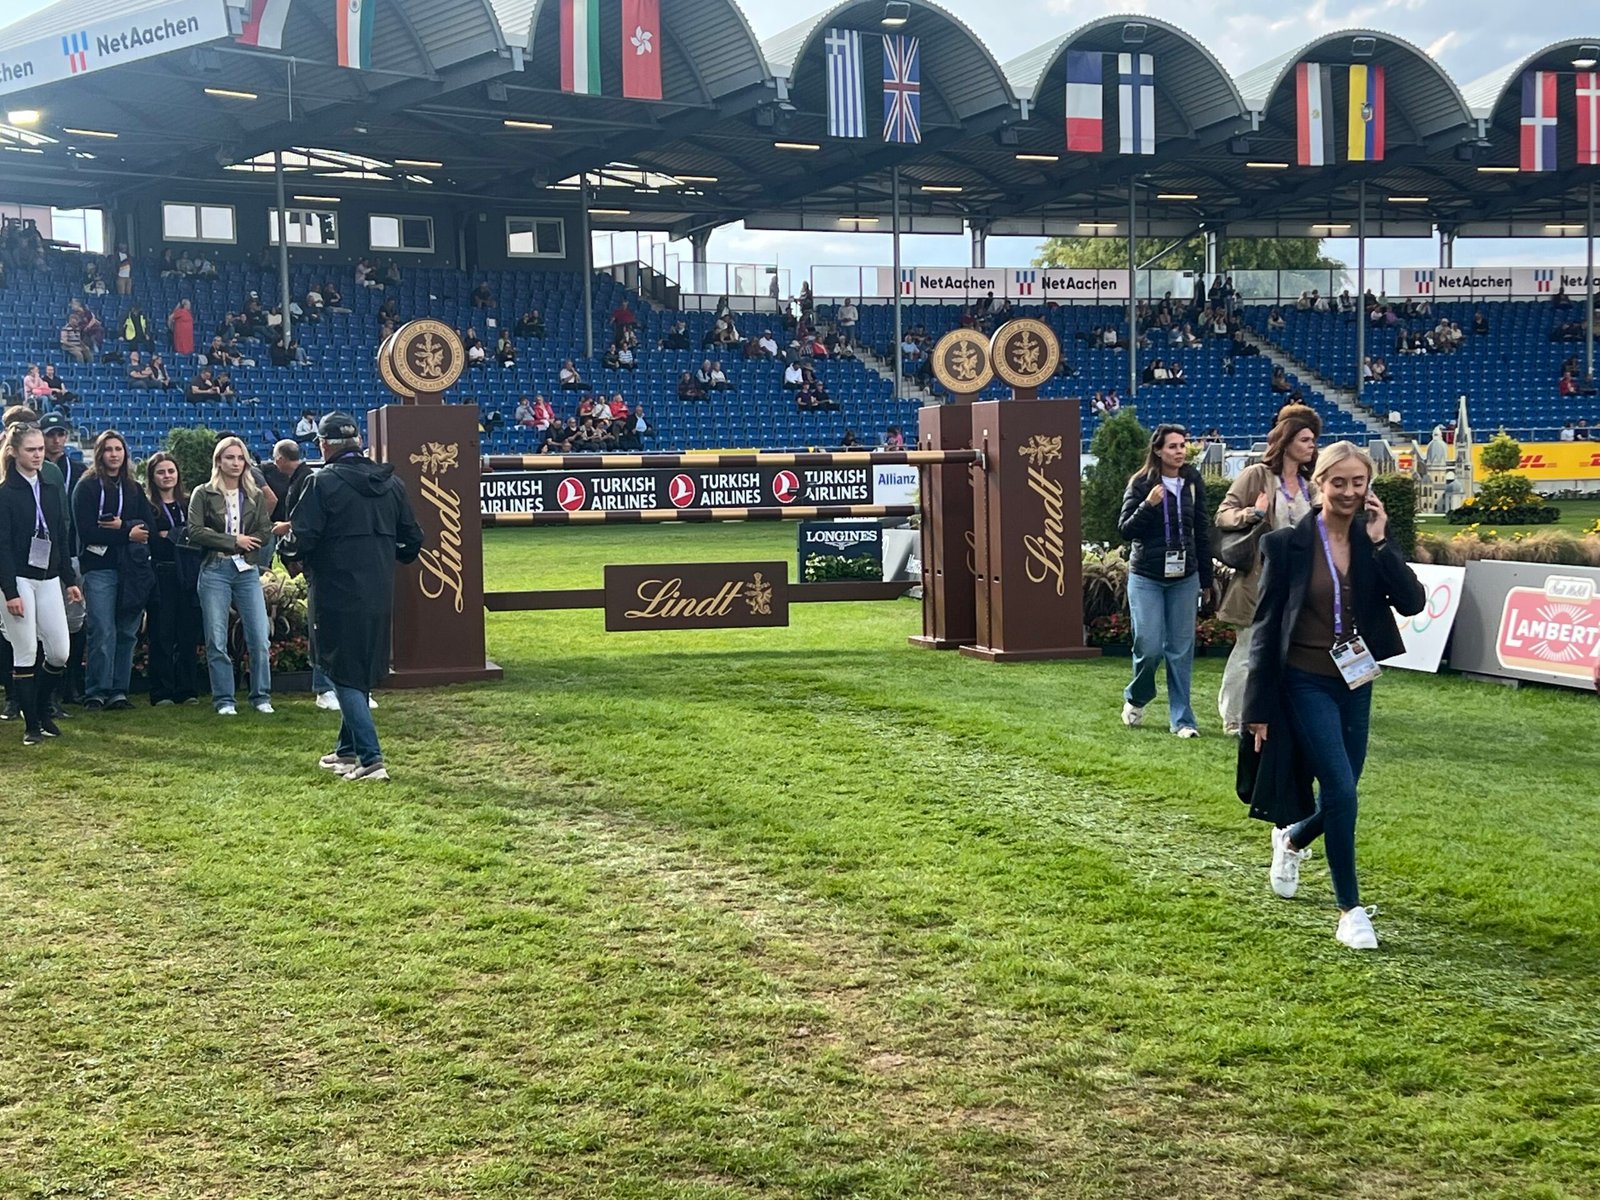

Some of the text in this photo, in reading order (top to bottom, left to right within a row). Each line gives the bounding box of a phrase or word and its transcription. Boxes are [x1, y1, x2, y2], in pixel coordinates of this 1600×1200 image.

[96, 16, 198, 56] NetAachen
[0, 61, 34, 82] hen
[920, 276, 995, 290] NetAachen
[1042, 277, 1117, 290] NetAachen
[1439, 275, 1512, 288] NetAachen
[591, 477, 656, 493] TURKISH
[700, 473, 760, 489] TURKISH
[804, 469, 867, 485] TURKISH
[878, 473, 916, 486] Allianz
[480, 480, 543, 497] TURKISH
[804, 486, 868, 500] AIRLINES
[480, 498, 544, 513] AIRLINES
[591, 494, 657, 510] AIRLINES
[700, 490, 761, 505] AIRLINES
[806, 530, 878, 543] LONGINES
[1023, 466, 1065, 597] Lindt
[418, 475, 464, 614] Lindt
[624, 578, 744, 619] Lindt
